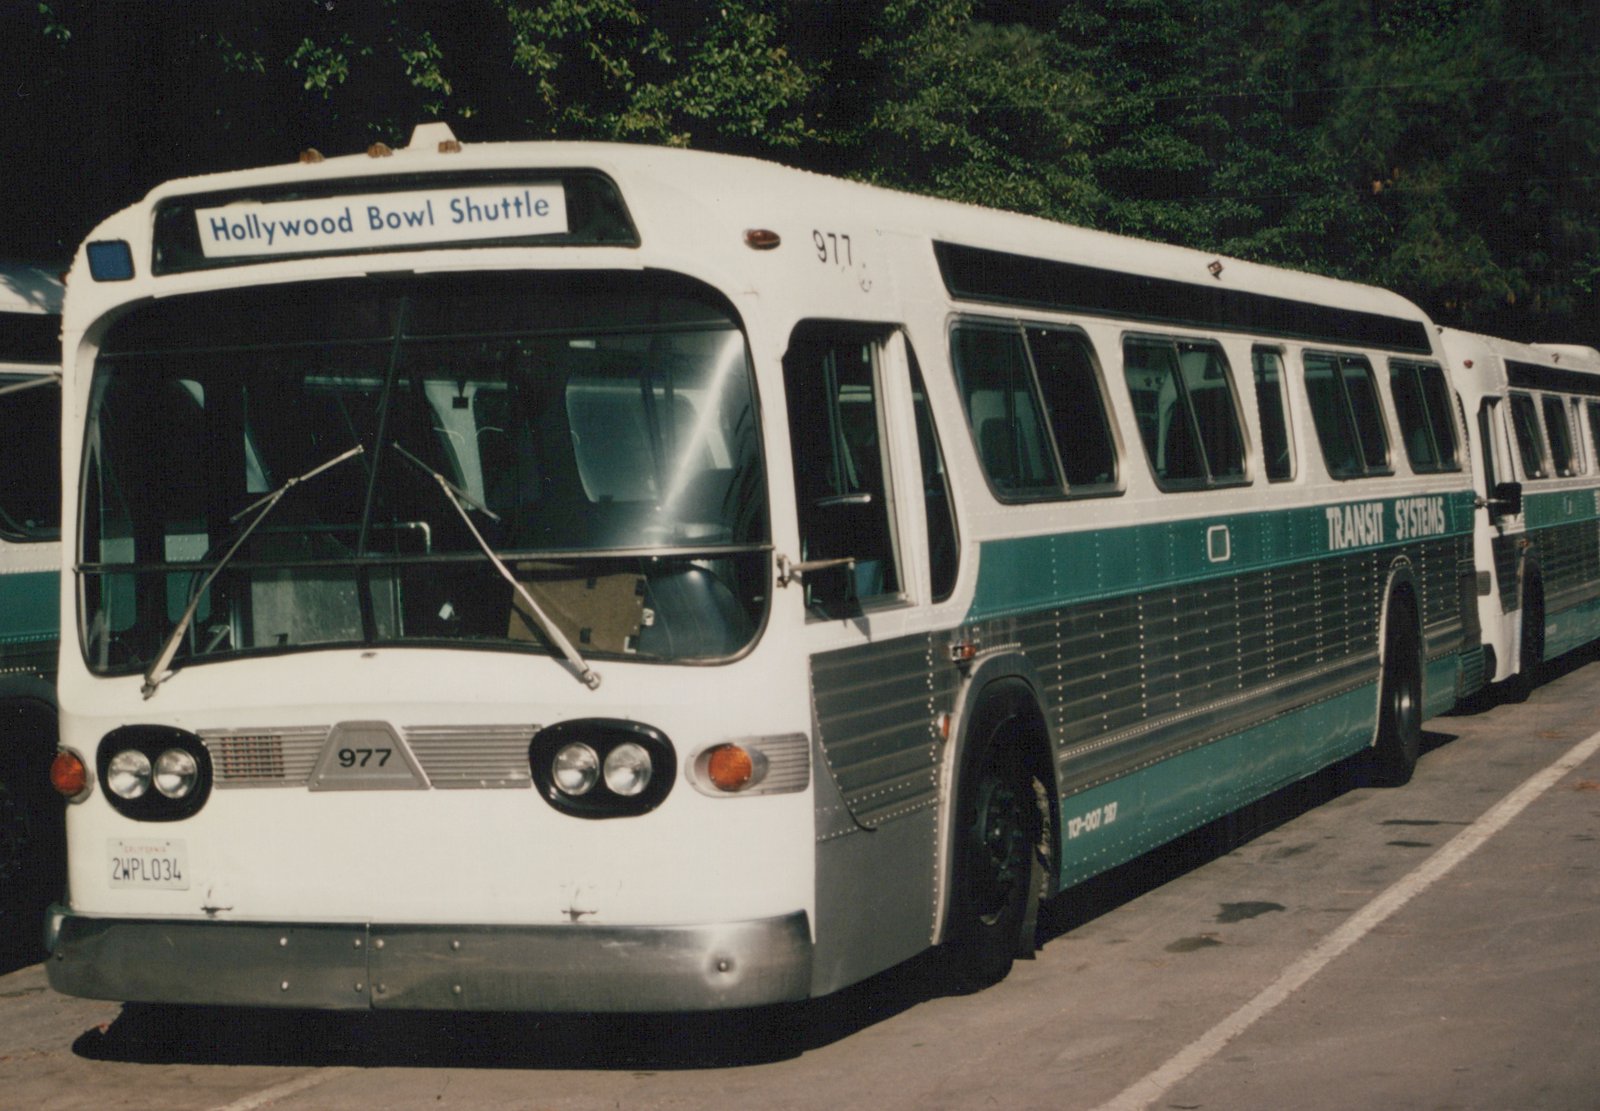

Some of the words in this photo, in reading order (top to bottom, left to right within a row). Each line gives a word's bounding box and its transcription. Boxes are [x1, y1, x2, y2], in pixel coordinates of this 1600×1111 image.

[210, 207, 353, 245] Hollywood
[366, 199, 434, 231] Bowl
[450, 190, 550, 223] Shuttle
[812, 229, 852, 266] 977
[1325, 502, 1384, 550] TRANSIT
[1394, 496, 1445, 540] SYSTEMS
[338, 748, 392, 768] 977
[112, 857, 182, 881] 2WPL034
